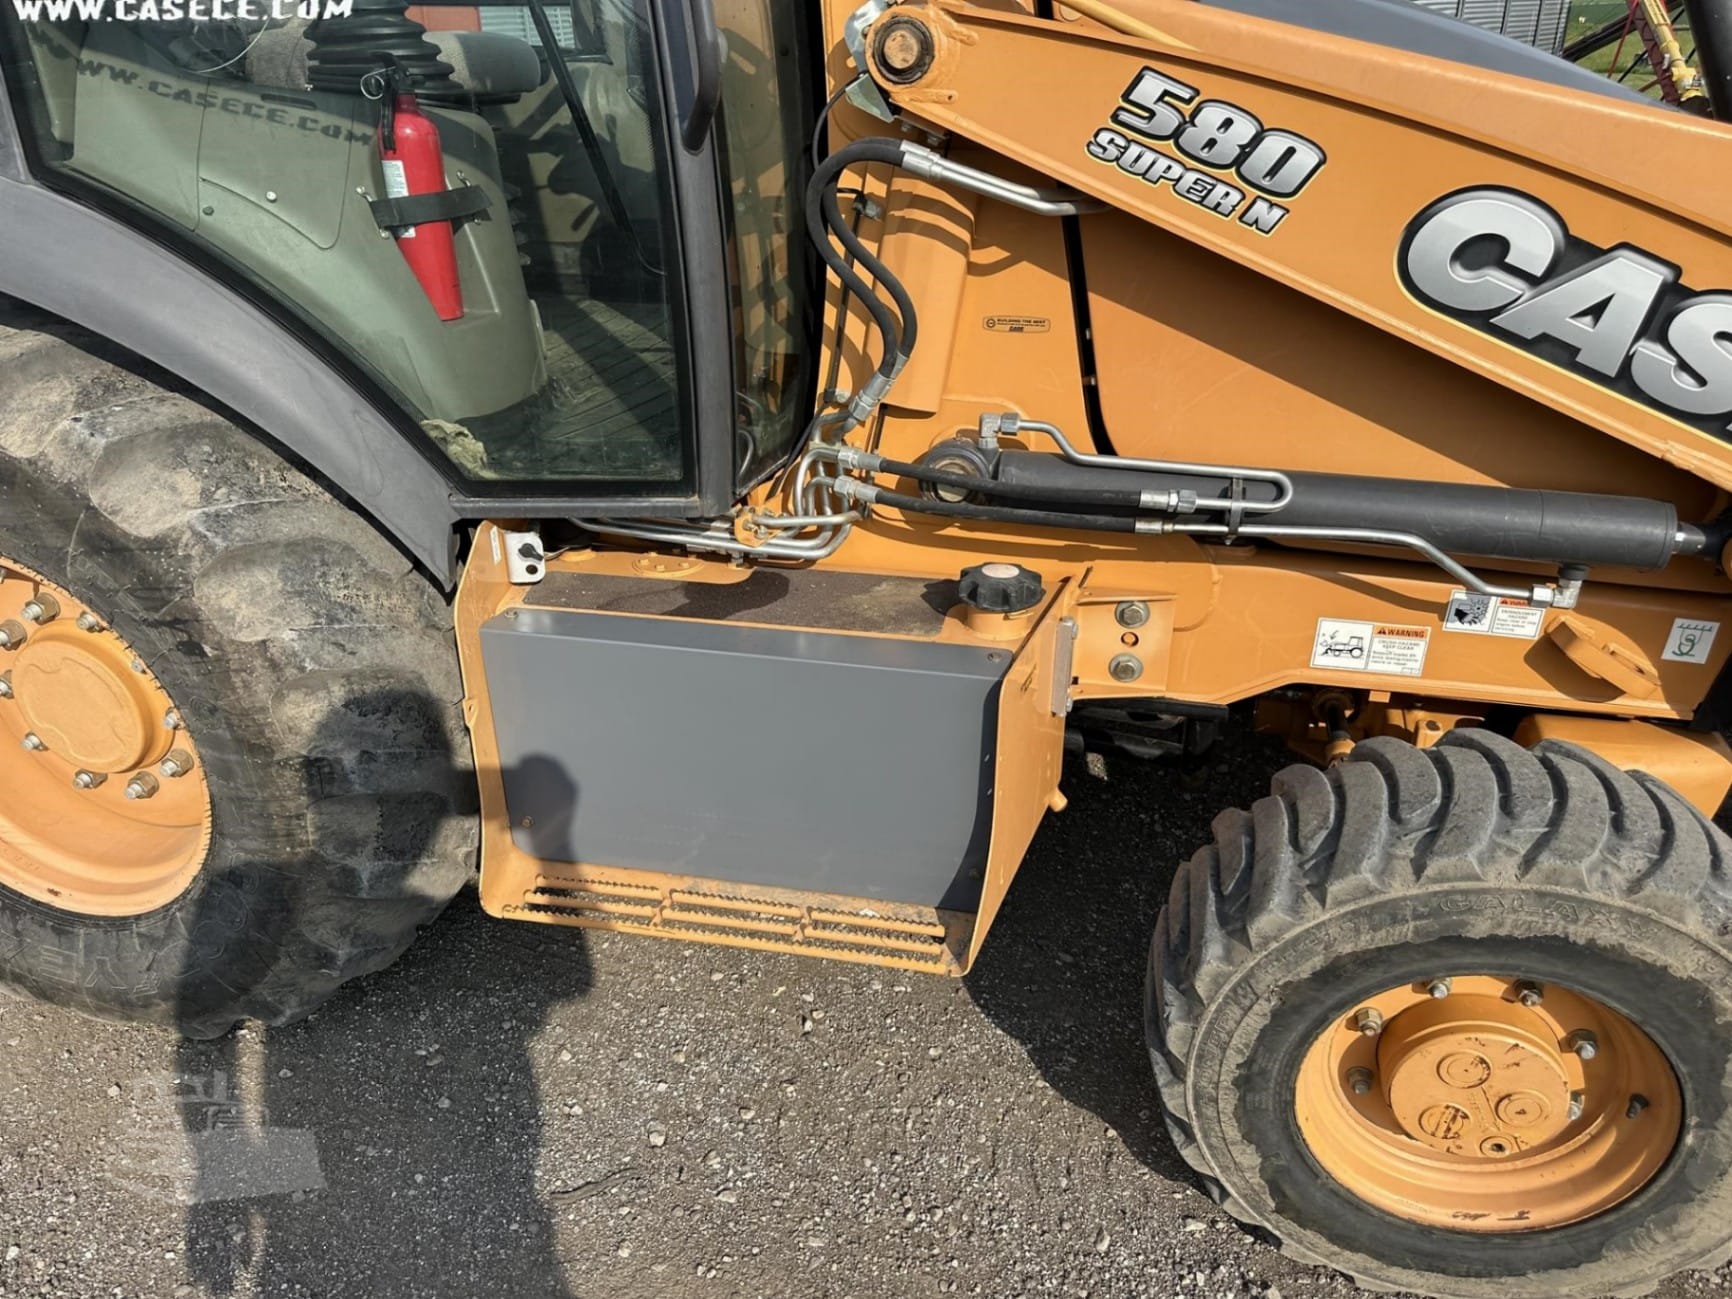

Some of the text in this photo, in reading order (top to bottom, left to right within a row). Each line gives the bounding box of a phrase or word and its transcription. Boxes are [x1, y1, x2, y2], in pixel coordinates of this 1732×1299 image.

[1086, 128, 1289, 235] SUPER N
[1111, 66, 1327, 197] 580
[1395, 184, 1732, 446] CAS
[1387, 628, 1425, 638] WARNING
